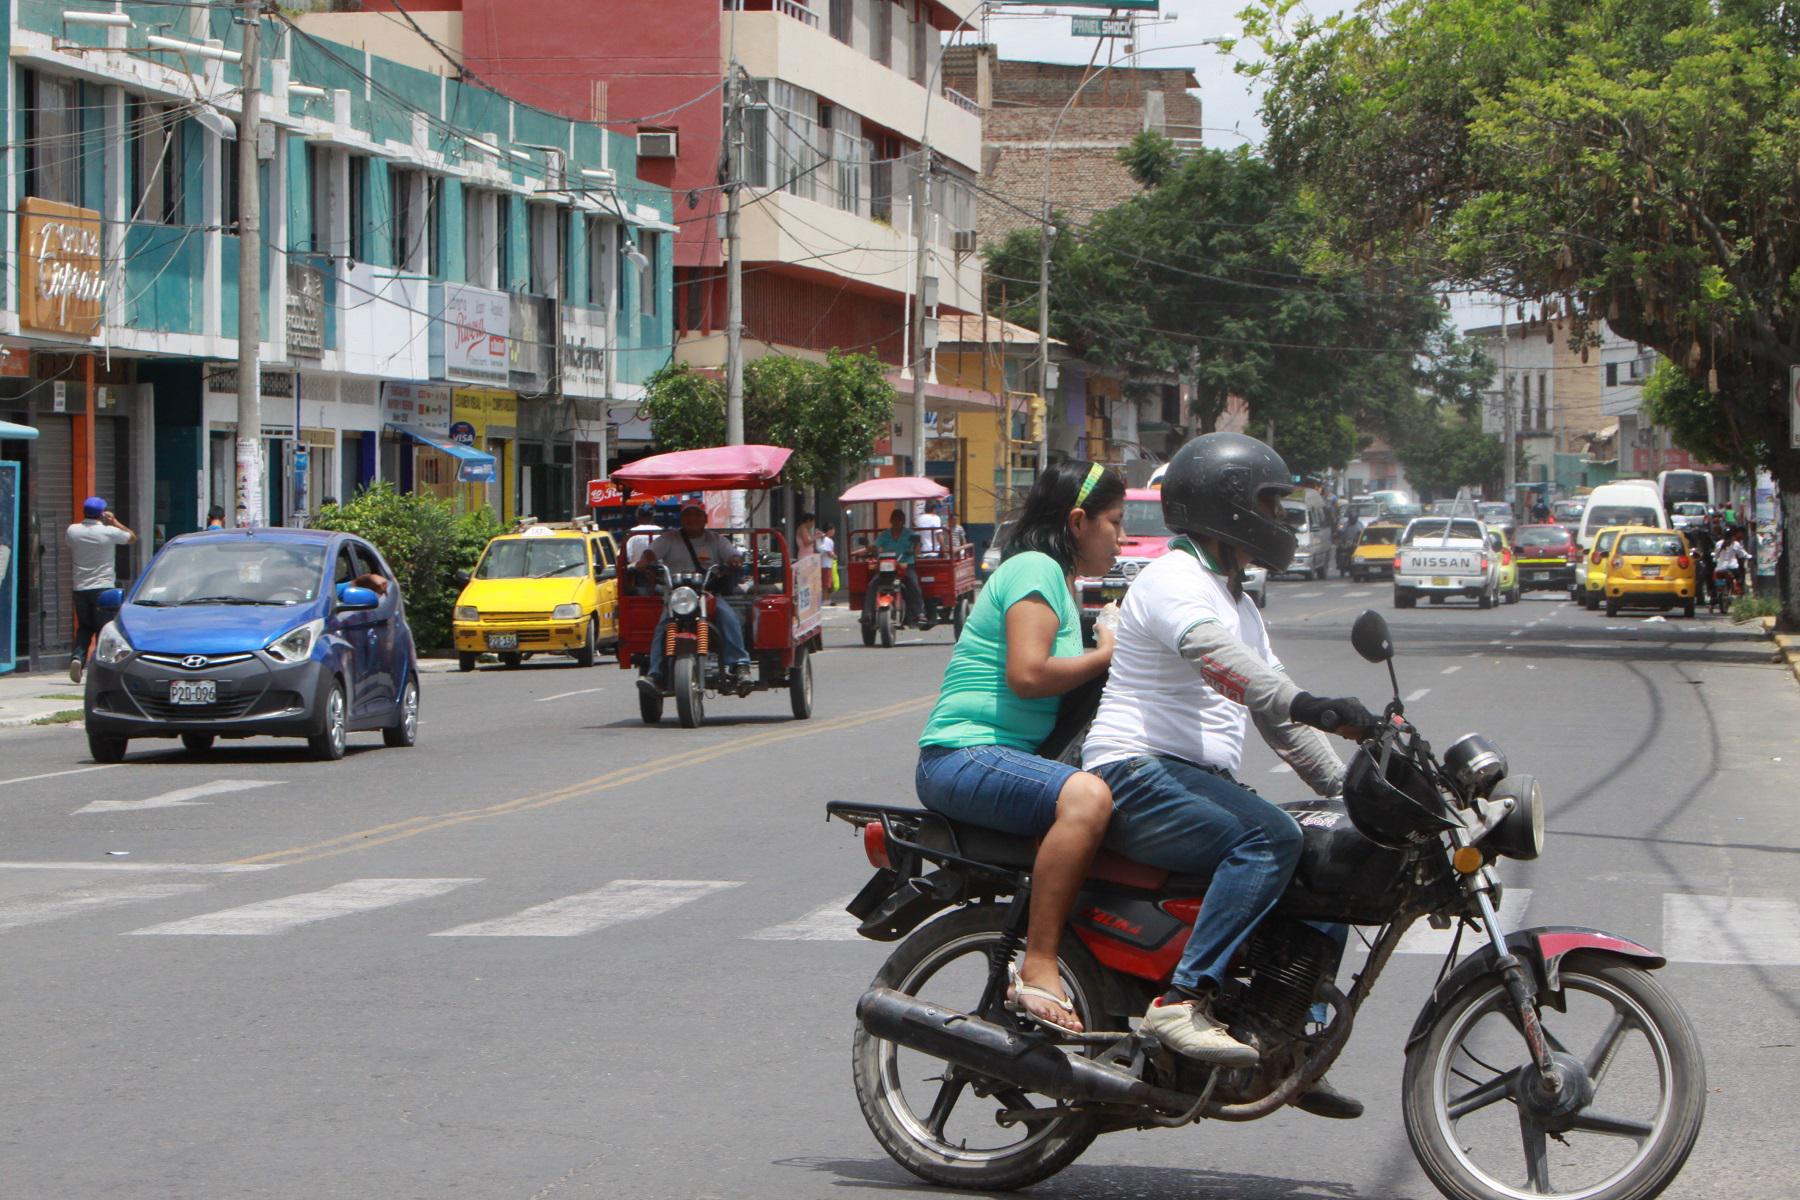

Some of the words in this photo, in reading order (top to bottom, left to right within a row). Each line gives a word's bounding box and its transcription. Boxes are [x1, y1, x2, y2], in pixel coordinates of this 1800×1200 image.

[1073, 20, 1100, 34] PANEL
[1102, 20, 1132, 35] SHOCK
[453, 433, 474, 443] VISA
[1412, 557, 1470, 567] NISSAN
